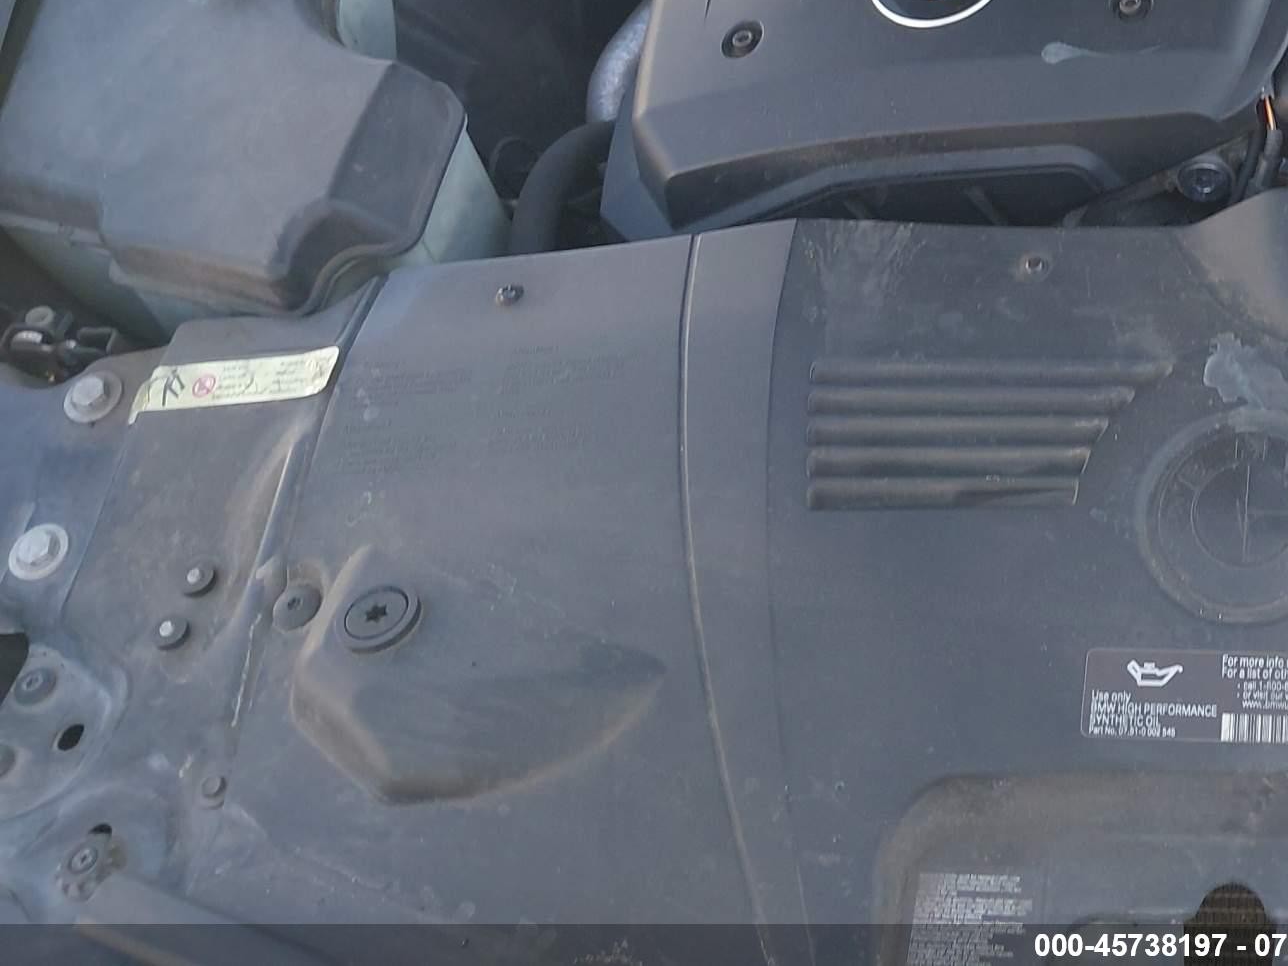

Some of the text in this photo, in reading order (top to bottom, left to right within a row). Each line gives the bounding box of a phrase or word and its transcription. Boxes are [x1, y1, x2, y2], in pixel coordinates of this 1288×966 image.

[1222, 653, 1238, 667] For
[1240, 656, 1264, 669] more
[1266, 655, 1284, 669] info
[1222, 666, 1238, 679] For
[1239, 668, 1246, 679] a
[1247, 666, 1261, 680] list
[1262, 667, 1273, 680] of
[1091, 689, 1132, 703] Use only
[1090, 701, 1218, 717] BMW HIGH PERFORMANCE
